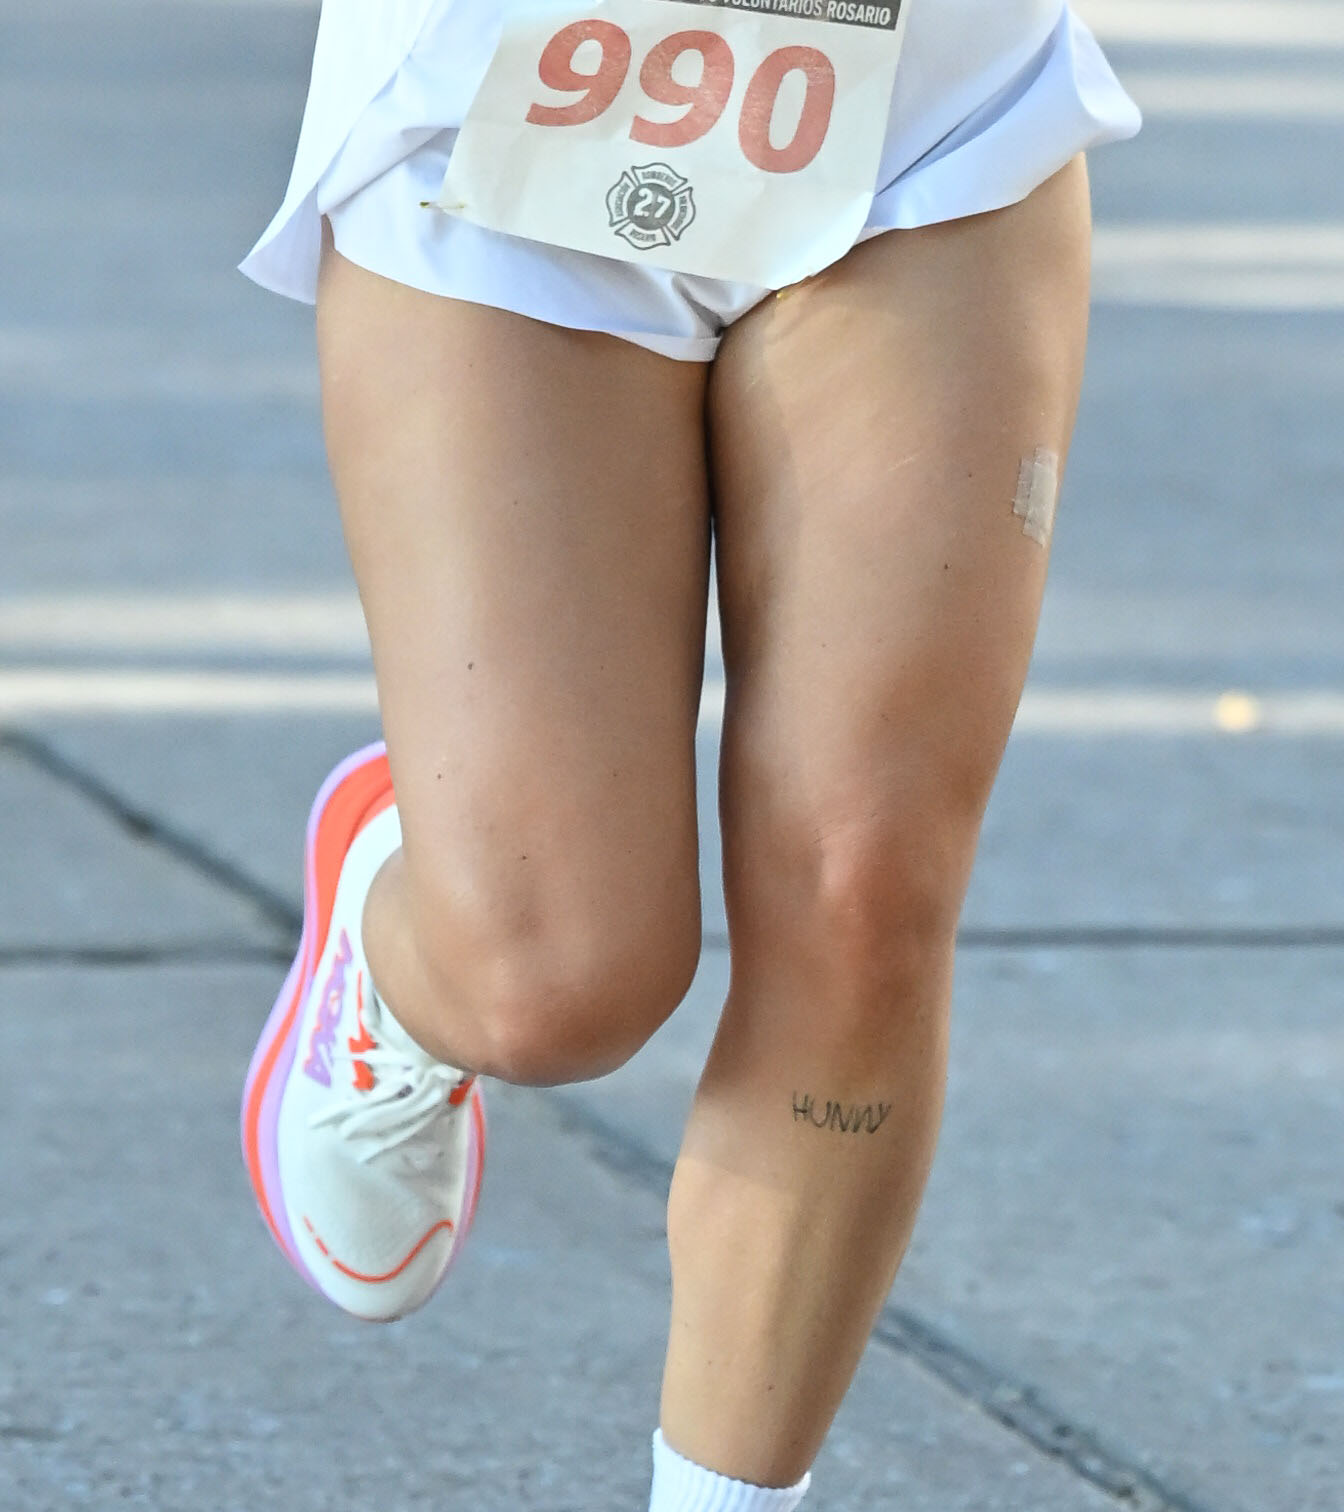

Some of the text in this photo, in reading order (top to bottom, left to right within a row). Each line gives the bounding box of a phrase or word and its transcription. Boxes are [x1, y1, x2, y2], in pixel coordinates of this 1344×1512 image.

[826, 0, 891, 26] ROSARIO
[524, 19, 836, 174] 990
[634, 187, 671, 218] 27
